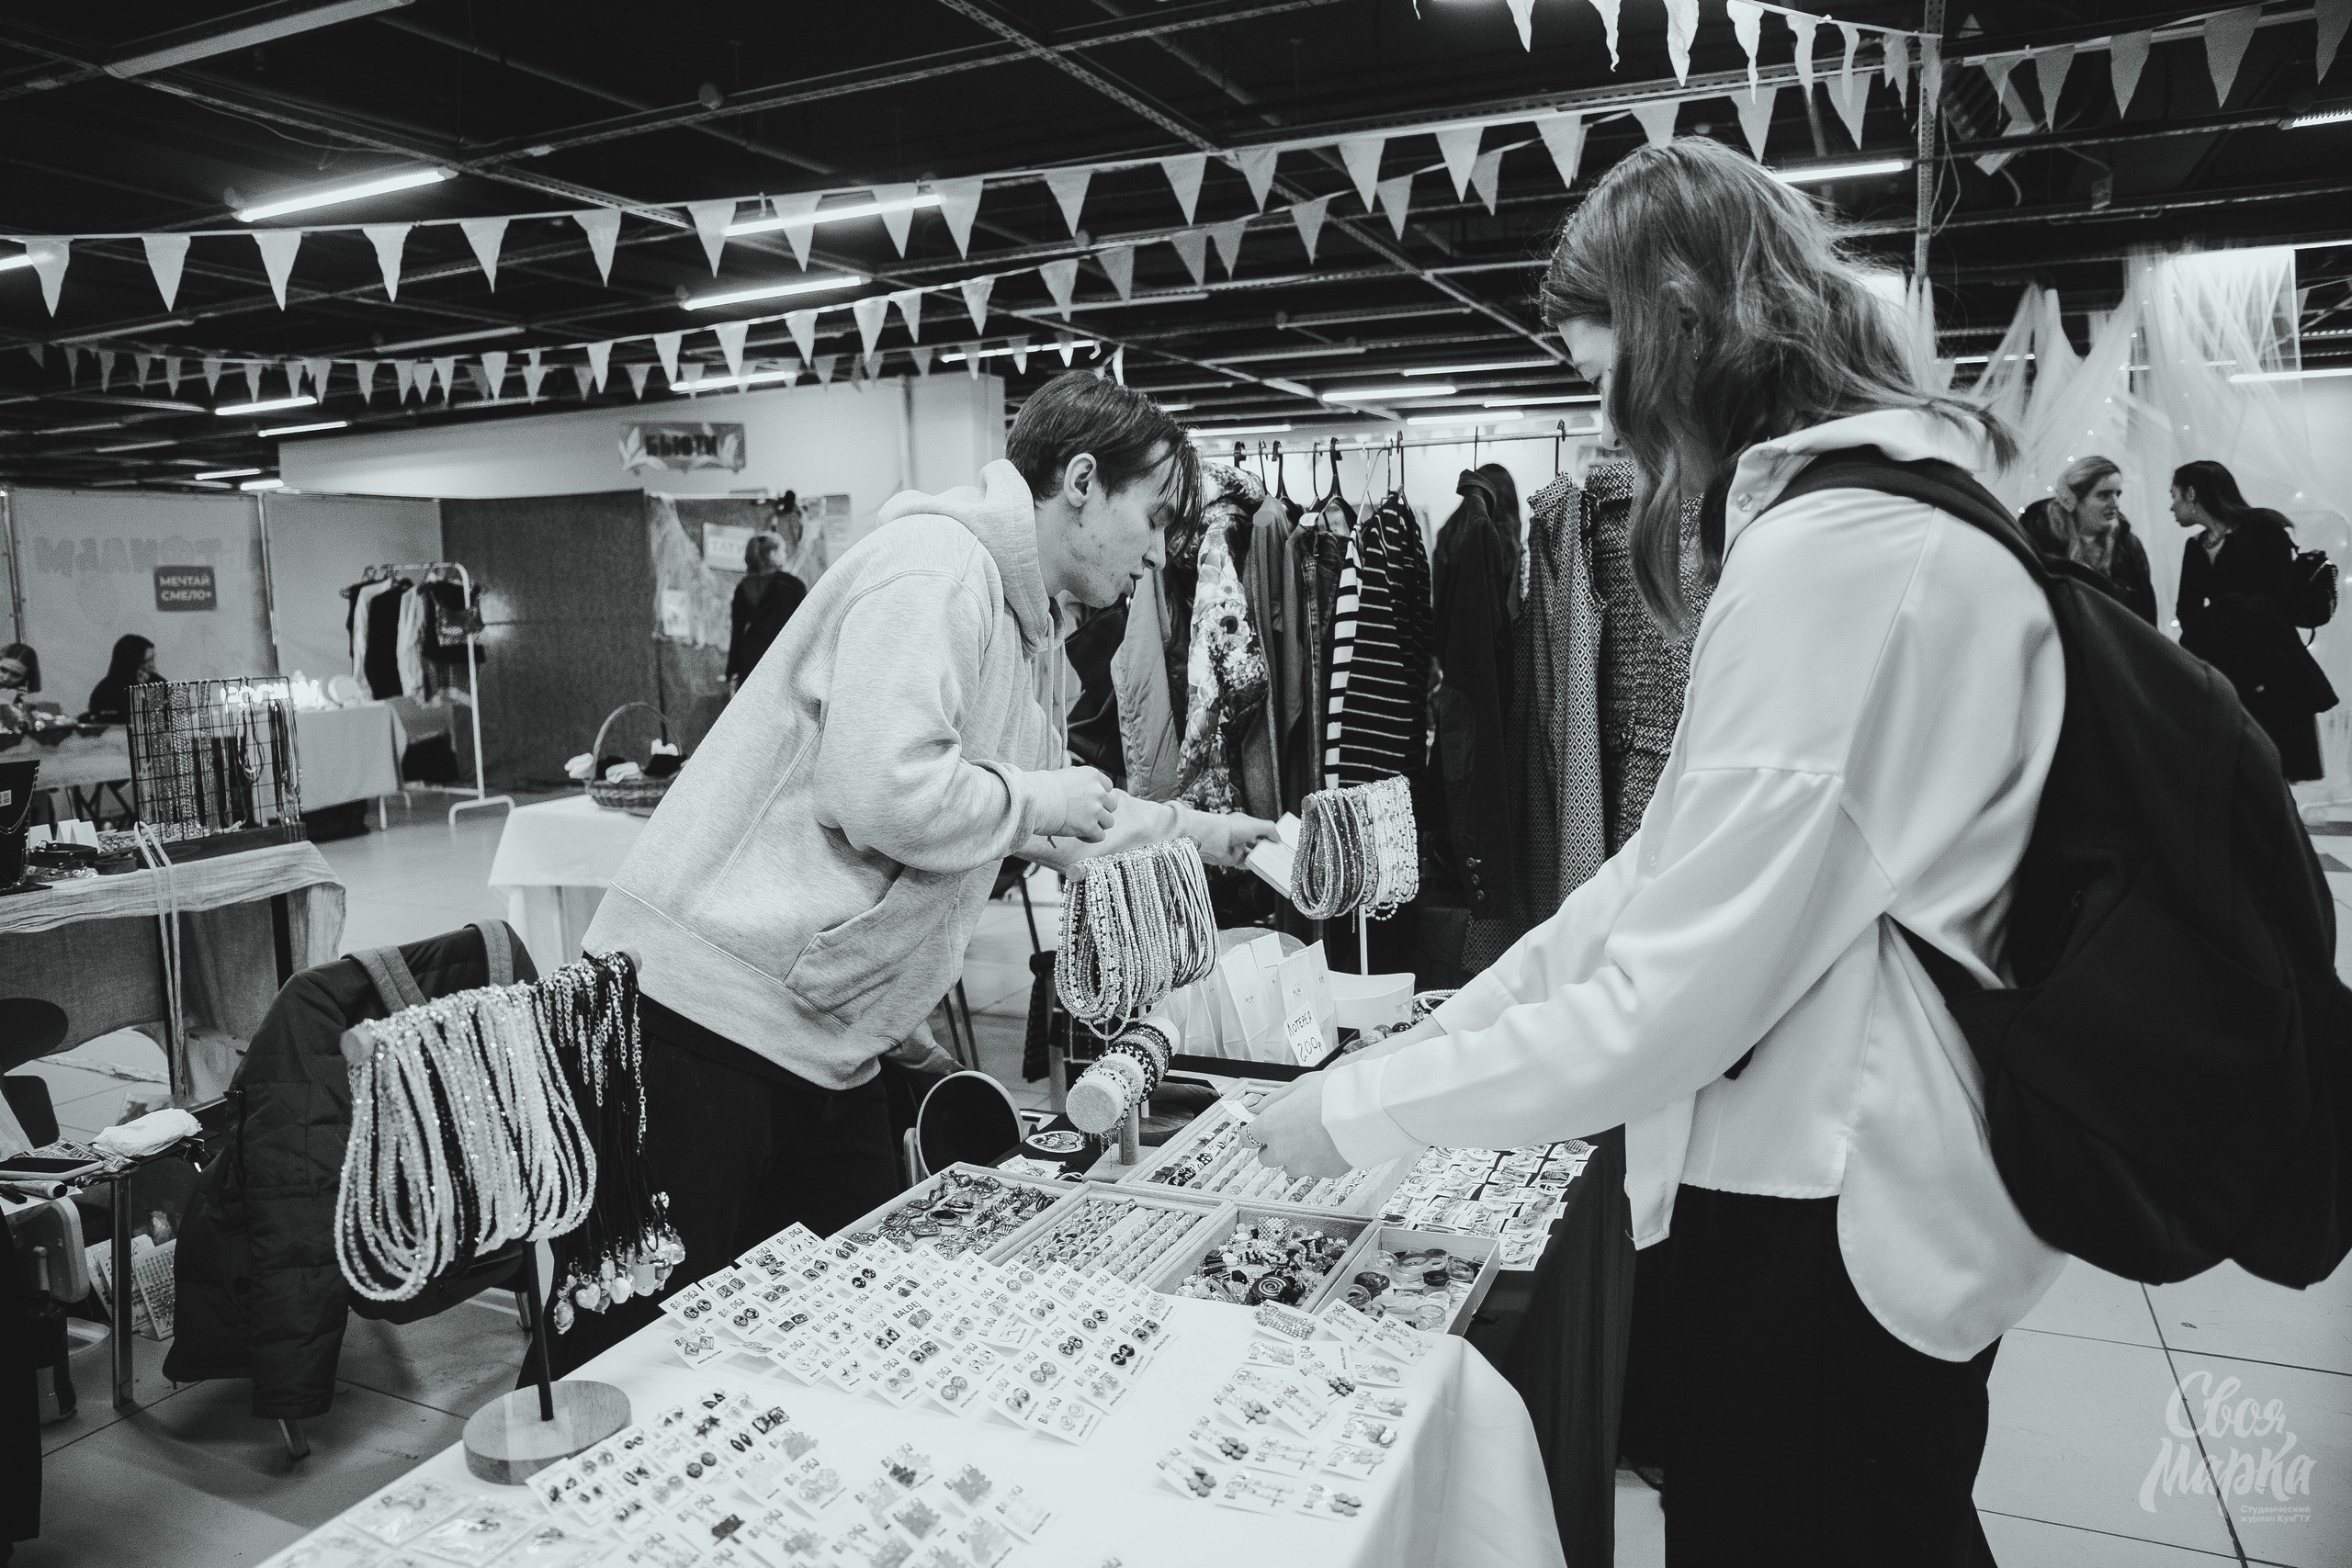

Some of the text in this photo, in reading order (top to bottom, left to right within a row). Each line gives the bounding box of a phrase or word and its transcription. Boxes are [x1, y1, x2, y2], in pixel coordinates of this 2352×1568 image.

[159, 574, 212, 587] МЕЧТАЙ
[776, 1227, 803, 1246] BADEJ
[791, 1254, 813, 1272] BADEJ
[837, 1262, 860, 1281] BADEJ
[996, 1264, 1020, 1284] BADEJ
[1044, 1268, 1067, 1289] BADEJ
[922, 1278, 947, 1297] BADEJ
[1087, 1275, 1110, 1296] BADEJ
[670, 1290, 699, 1310] BADEJ
[718, 1298, 745, 1318] BADEJ
[845, 1293, 870, 1314] BADEJ
[971, 1287, 995, 1309] BADEJ
[892, 1301, 922, 1319] BALDEJ
[1069, 1301, 1092, 1321] BADEJ
[812, 1312, 839, 1333] BADEJ
[1120, 1314, 1144, 1335] BADEJ
[777, 1339, 806, 1359] BADEJ
[952, 1343, 978, 1365] BADEJ
[1094, 1336, 1115, 1360] BADEJ
[869, 1358, 899, 1382] BADEJ
[1013, 1351, 1039, 1373] BADEJ
[925, 1366, 953, 1389] BADEJ
[1074, 1364, 1099, 1387] BADEJ
[1038, 1397, 1062, 1425] BADEJ
